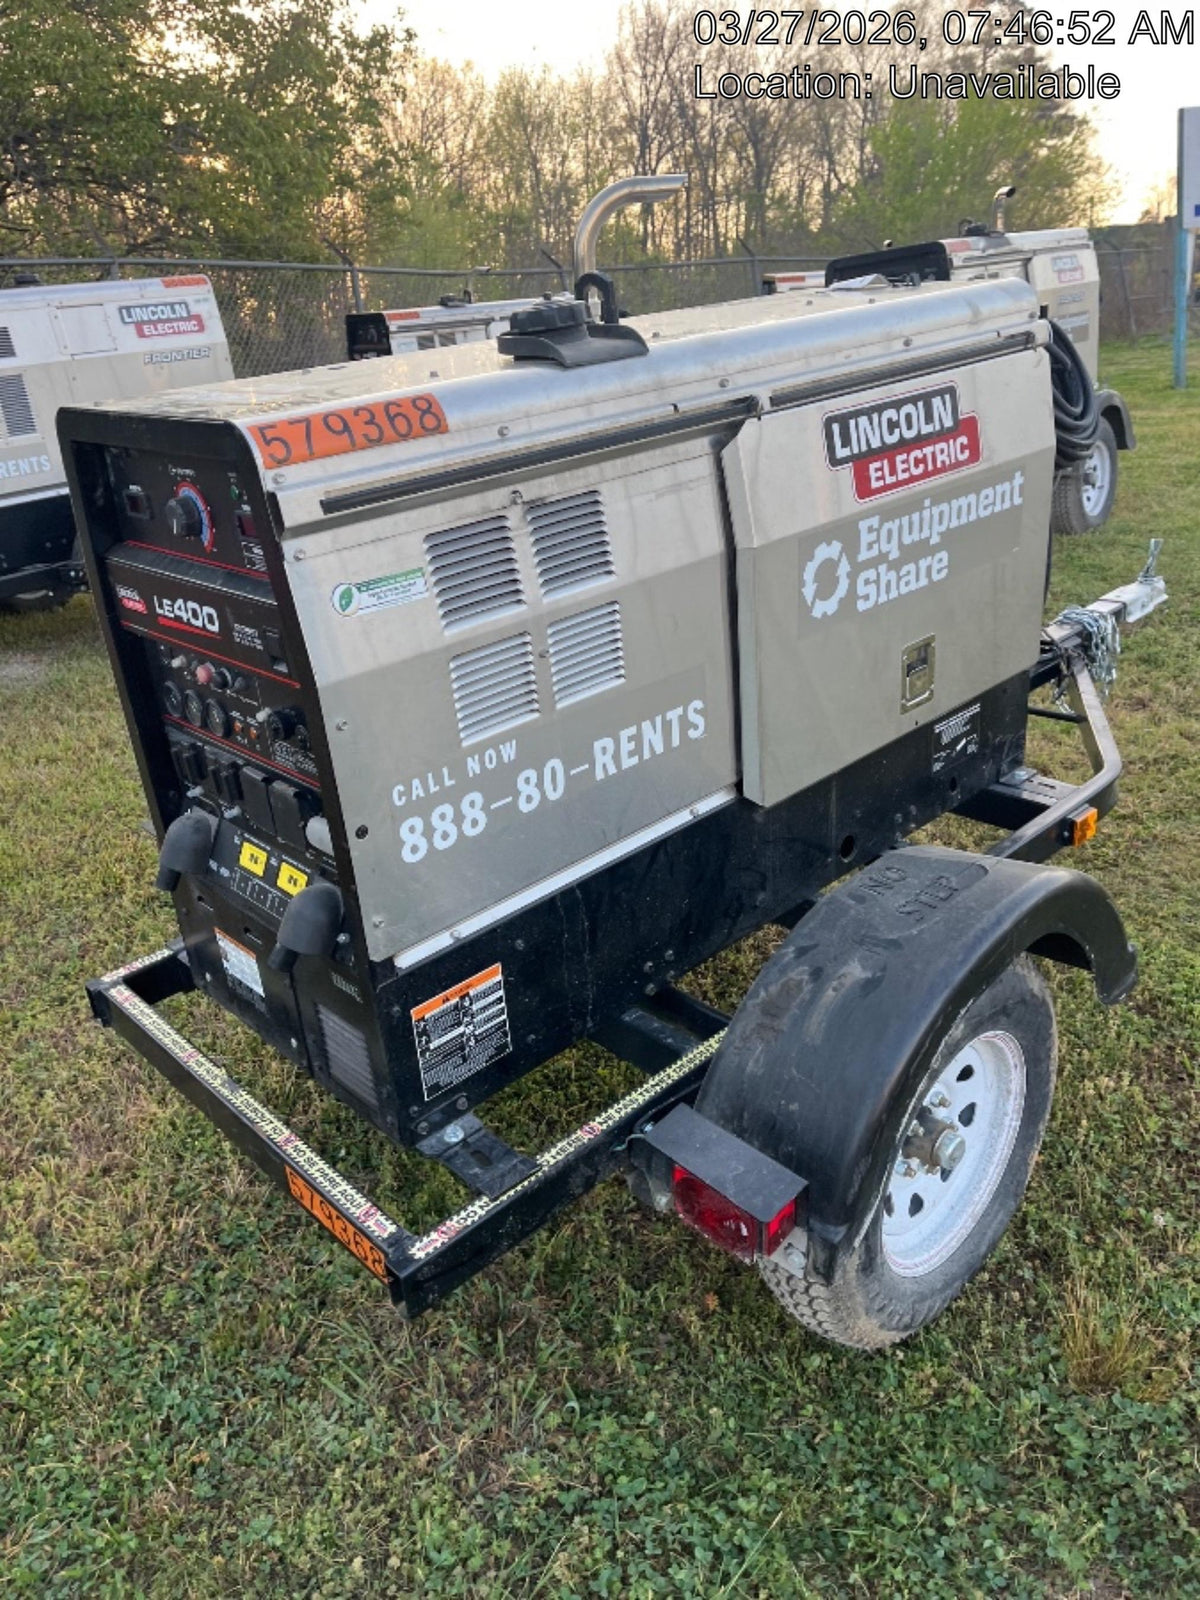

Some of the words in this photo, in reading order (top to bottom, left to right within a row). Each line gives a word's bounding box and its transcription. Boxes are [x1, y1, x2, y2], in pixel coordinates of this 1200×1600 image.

[121, 303, 188, 323] LINCOLN
[143, 320, 200, 335] ELECTRIC
[143, 346, 211, 365] FRONTIER
[257, 395, 443, 465] 579368
[831, 393, 955, 460] LINCOLN
[868, 434, 970, 490] ELECTRIC
[857, 470, 1025, 562] Equipment
[856, 549, 949, 613] Share
[153, 594, 219, 633] LE400
[392, 766, 456, 806] CALL
[466, 739, 518, 777] NOW
[399, 699, 706, 864] 888-80-RENTS
[858, 866, 907, 897] NO
[895, 875, 960, 922] STEP
